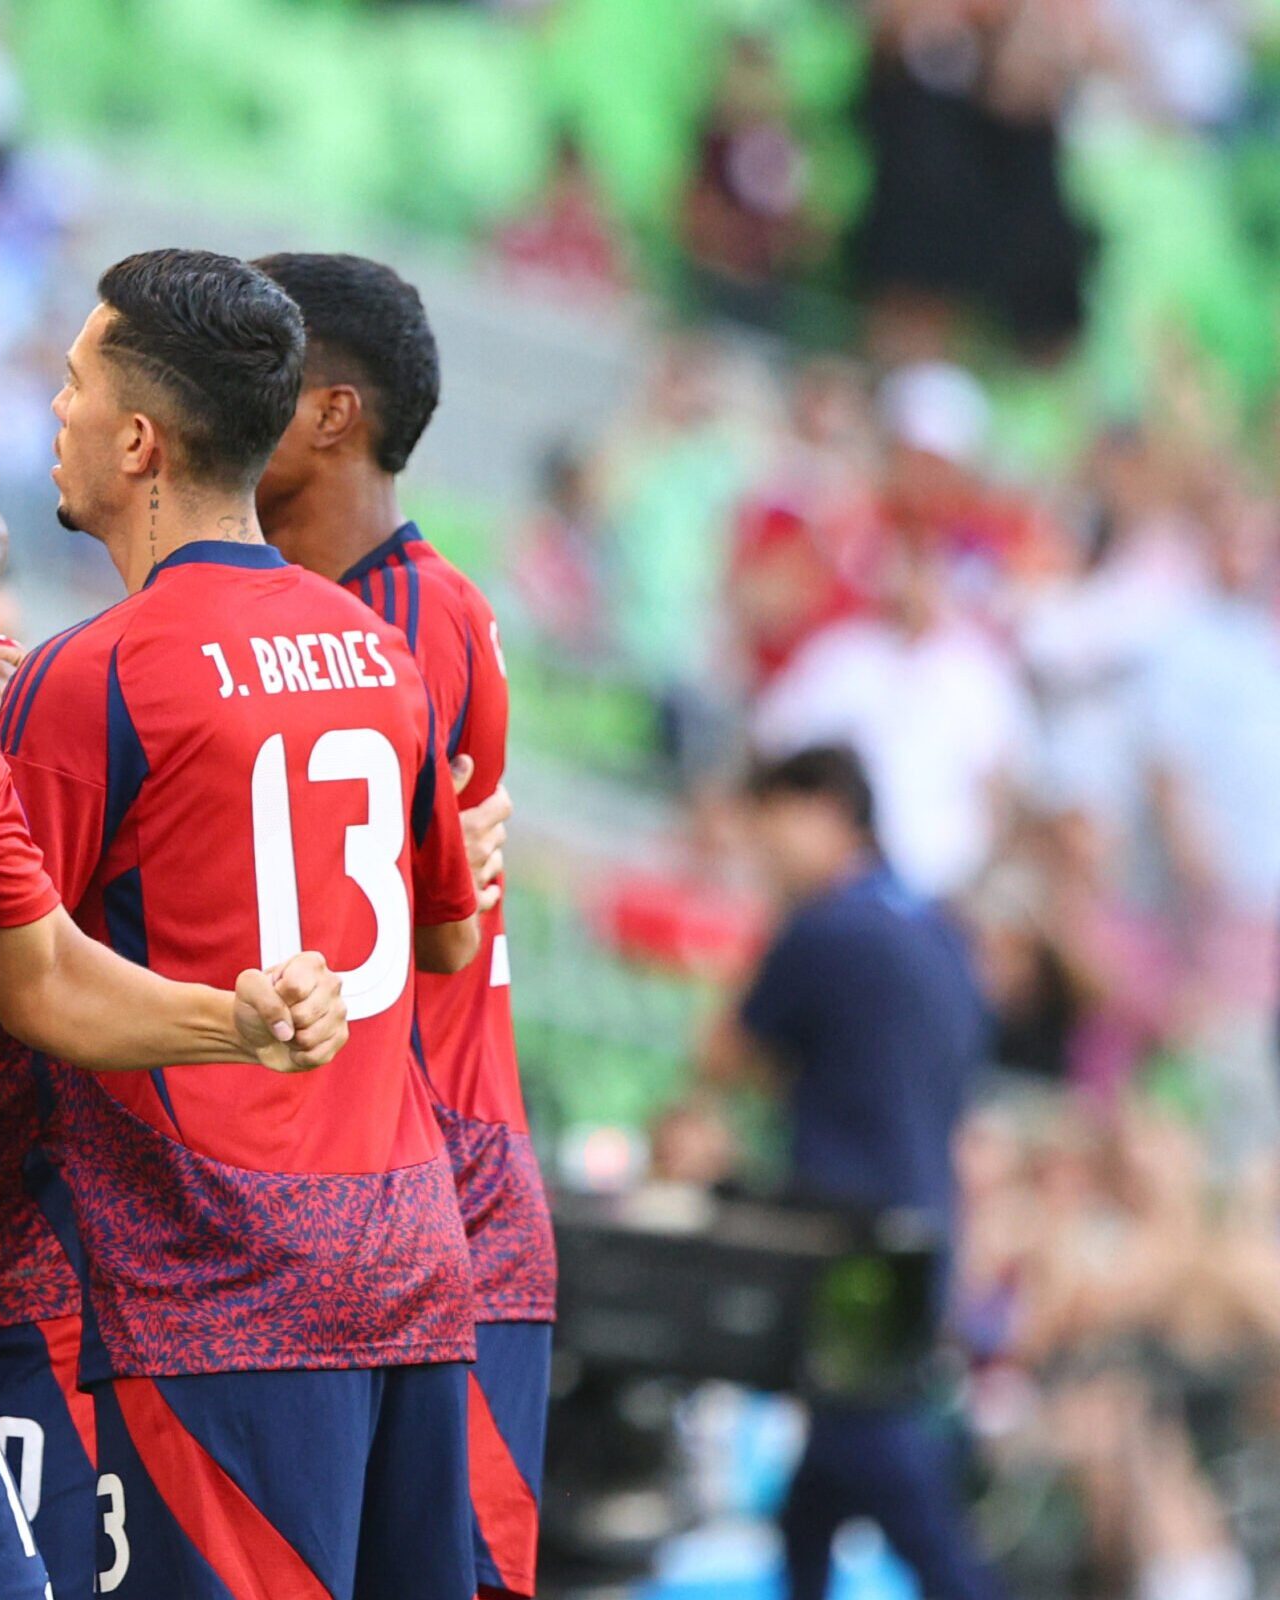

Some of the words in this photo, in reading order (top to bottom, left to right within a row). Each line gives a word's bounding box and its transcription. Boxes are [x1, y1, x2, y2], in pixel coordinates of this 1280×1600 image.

[150, 467, 159, 565] FAMILI
[201, 642, 250, 698] J.
[249, 630, 397, 694] BRENES
[251, 728, 412, 1021] 13
[93, 1473, 130, 1593] 3
